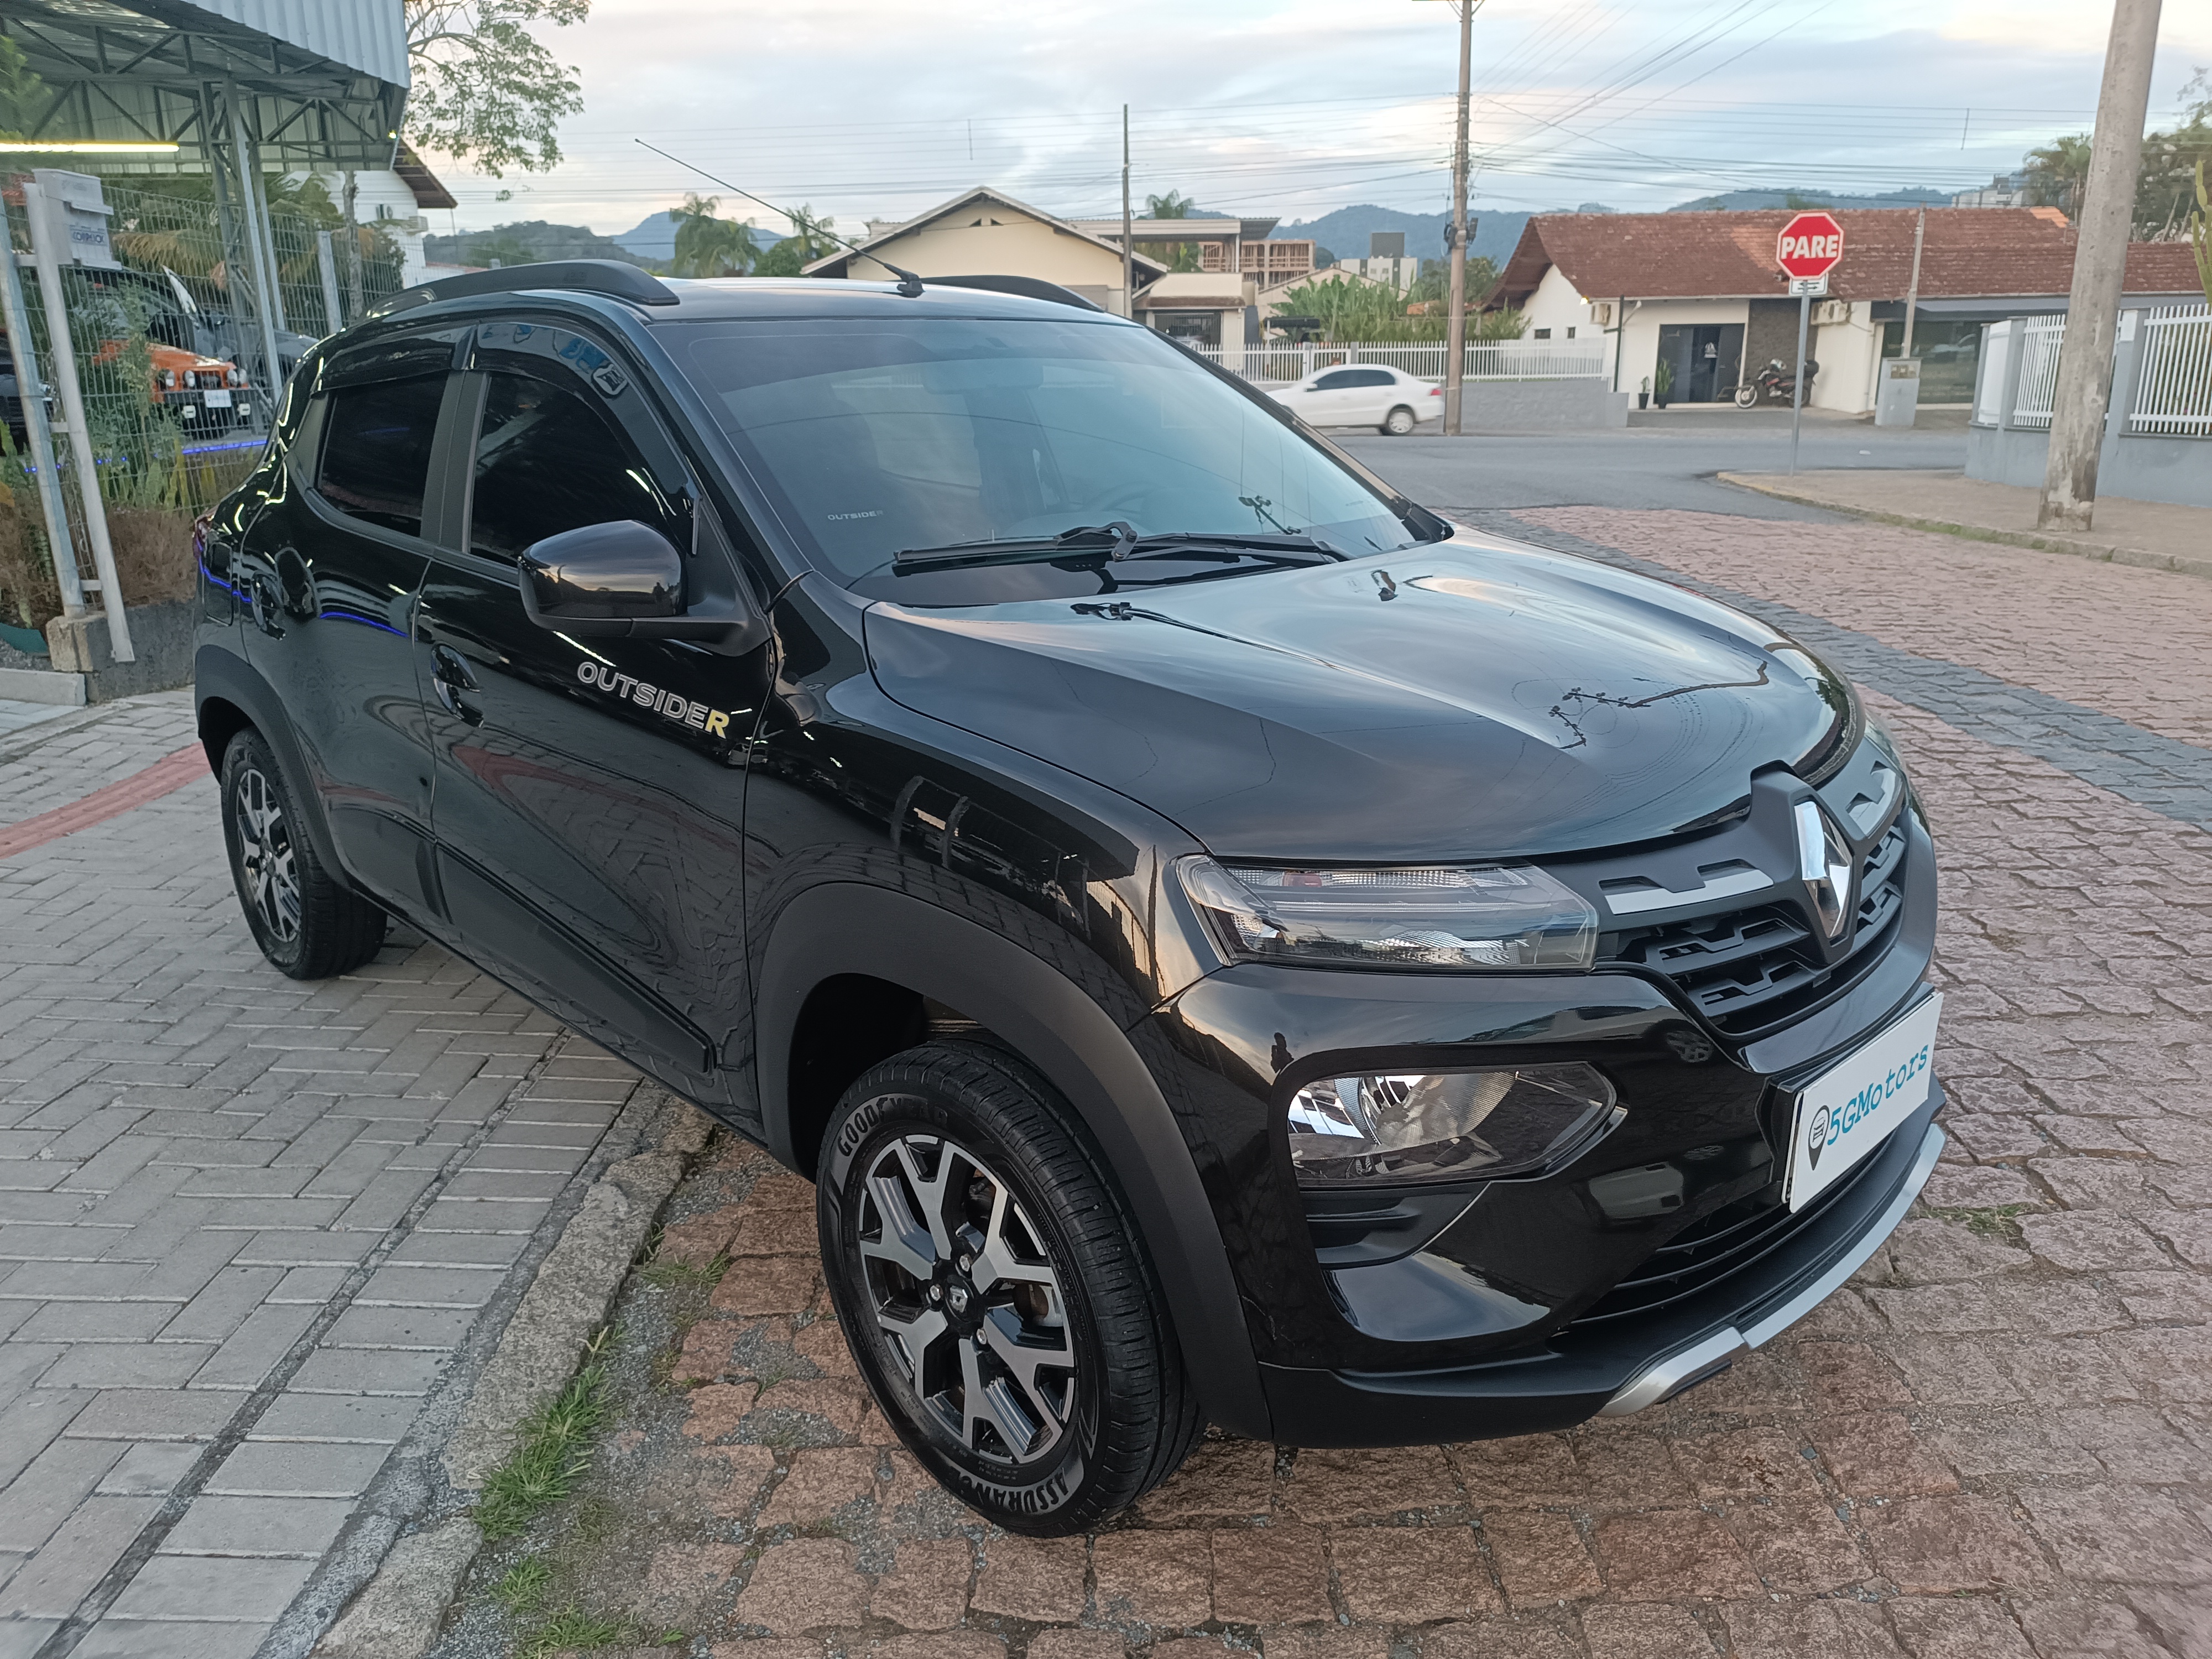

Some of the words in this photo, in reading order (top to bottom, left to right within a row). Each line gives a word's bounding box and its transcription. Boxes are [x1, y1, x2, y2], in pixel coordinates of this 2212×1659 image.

[1781, 234, 1839, 259] PARE
[577, 661, 729, 739] OUTSIDER
[1827, 1045, 1928, 1146] 5GMotors
